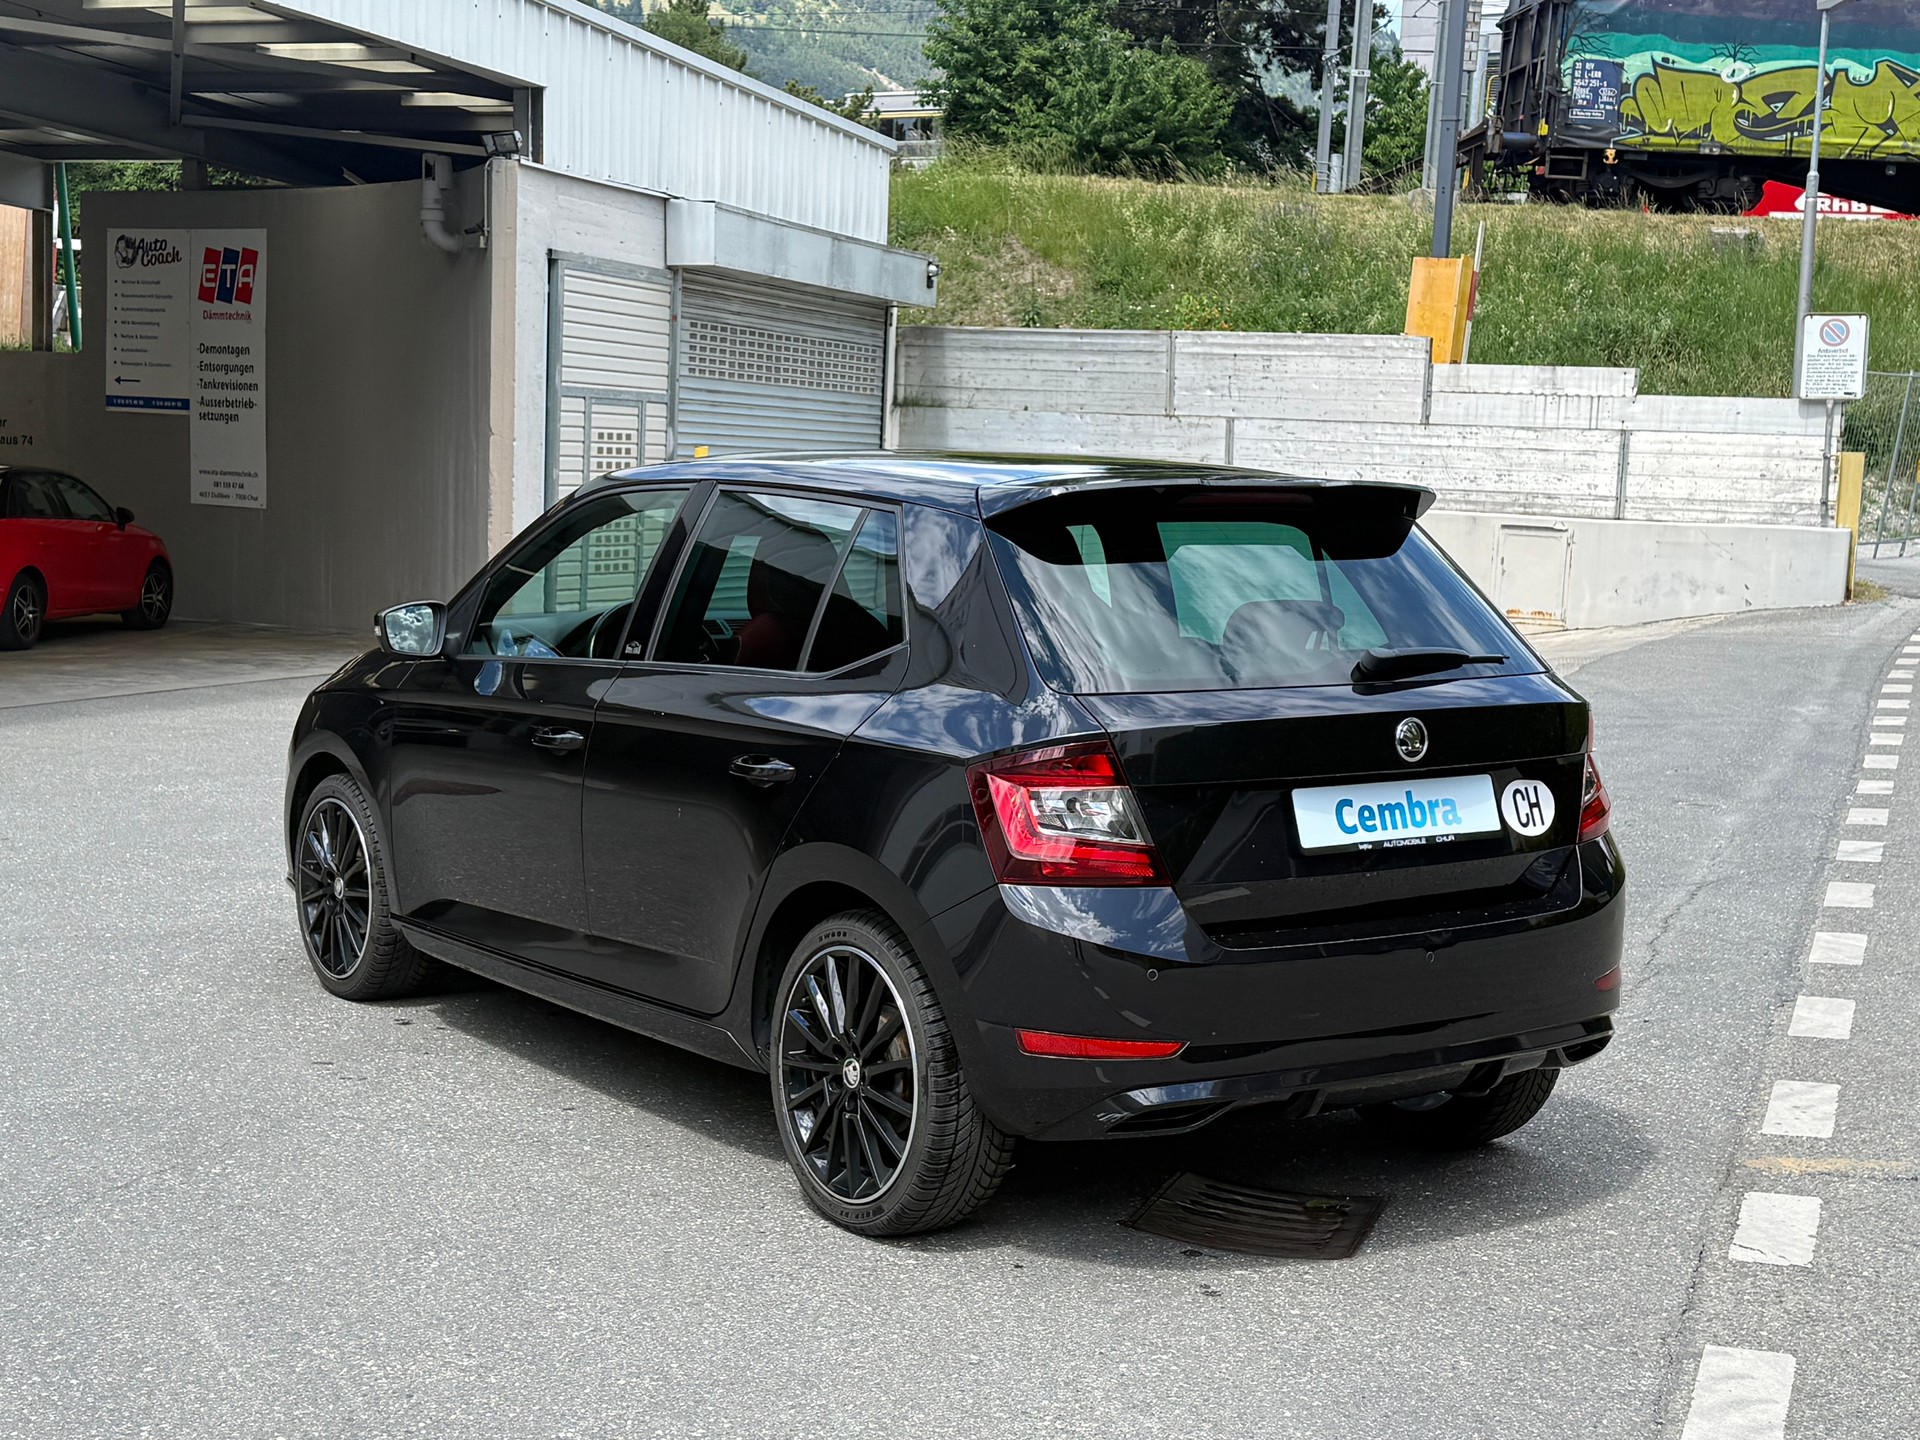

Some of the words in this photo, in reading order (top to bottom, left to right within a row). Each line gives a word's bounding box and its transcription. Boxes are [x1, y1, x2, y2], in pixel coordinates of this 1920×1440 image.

[136, 238, 168, 253] Auto
[141, 246, 182, 267] Coach
[202, 263, 254, 288] ETA
[203, 310, 252, 321] Dämmtechnik
[199, 411, 239, 424] setzungen
[21, 434, 33, 446] 74
[1334, 790, 1462, 835] Cembra
[1512, 785, 1545, 829] CH
[1383, 837, 1427, 848] AUTOMOBILE
